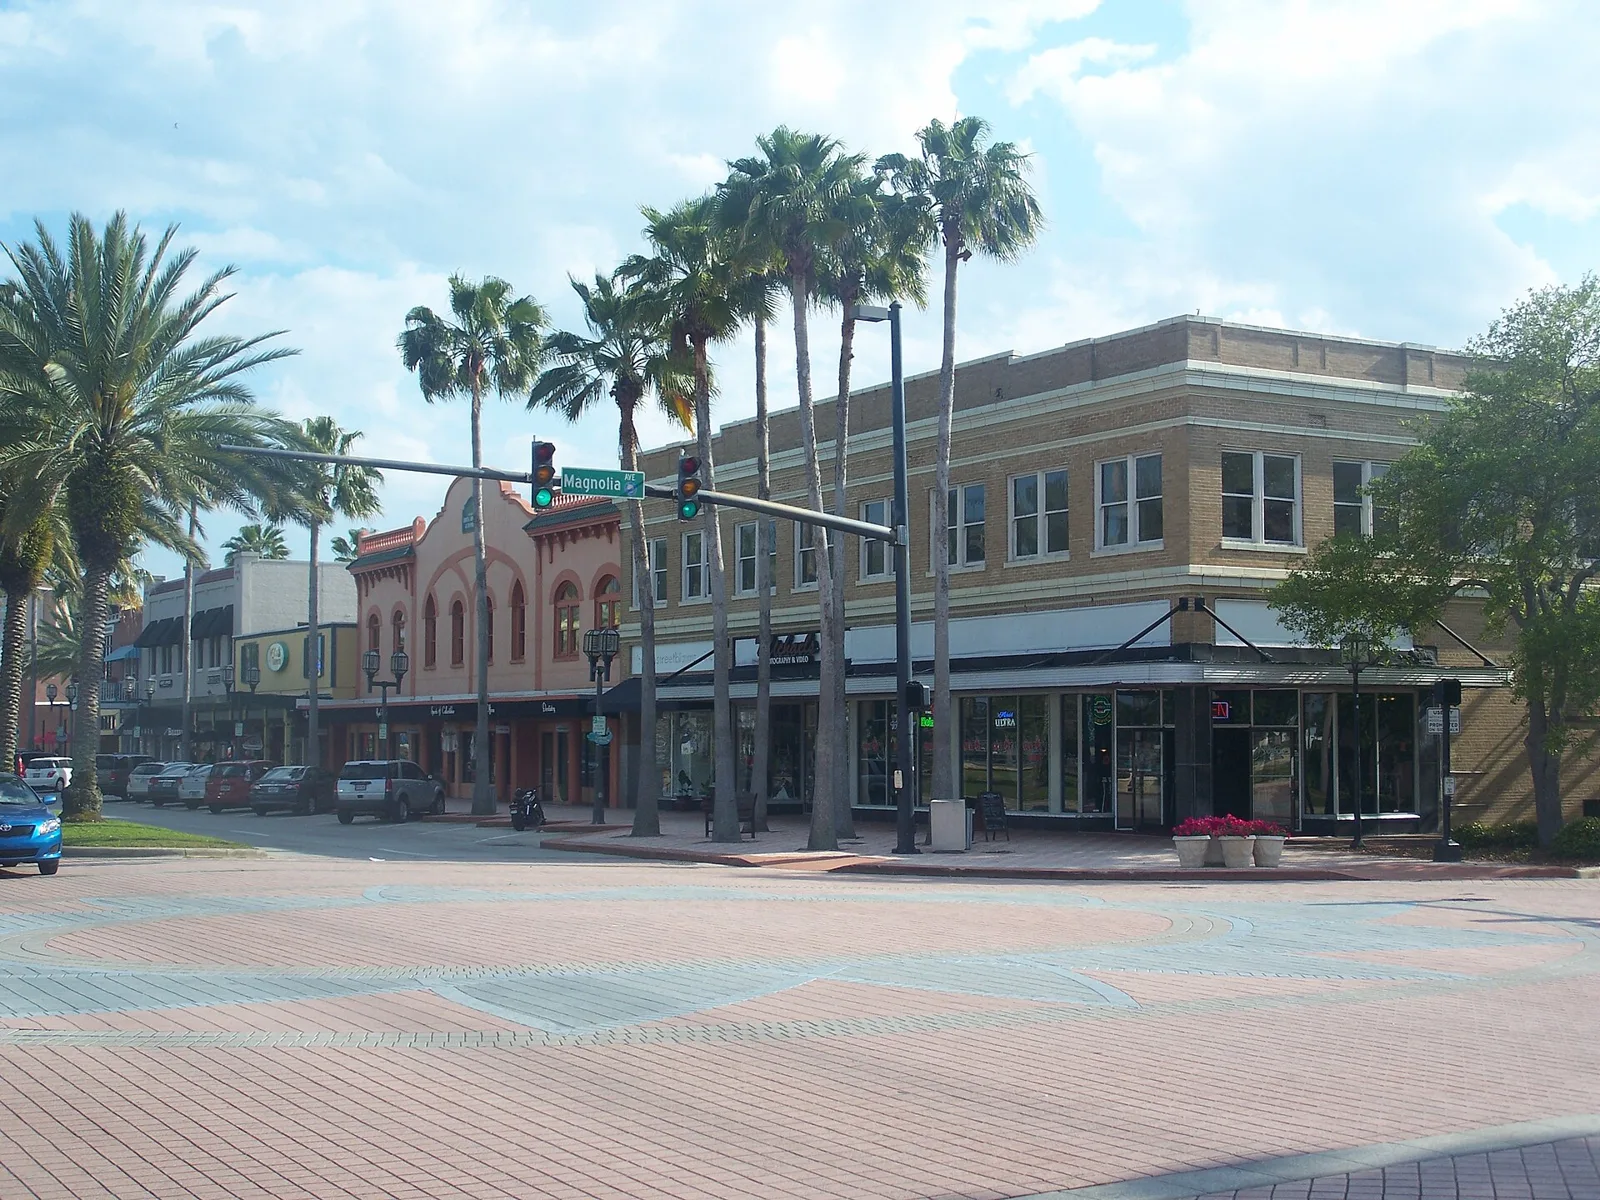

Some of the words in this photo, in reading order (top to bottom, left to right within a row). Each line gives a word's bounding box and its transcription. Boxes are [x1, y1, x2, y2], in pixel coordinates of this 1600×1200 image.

[624, 473, 636, 481] AVE
[564, 473, 621, 493] Magnolia
[796, 655, 809, 664] VIDEO
[994, 717, 1016, 727] ULTRA
